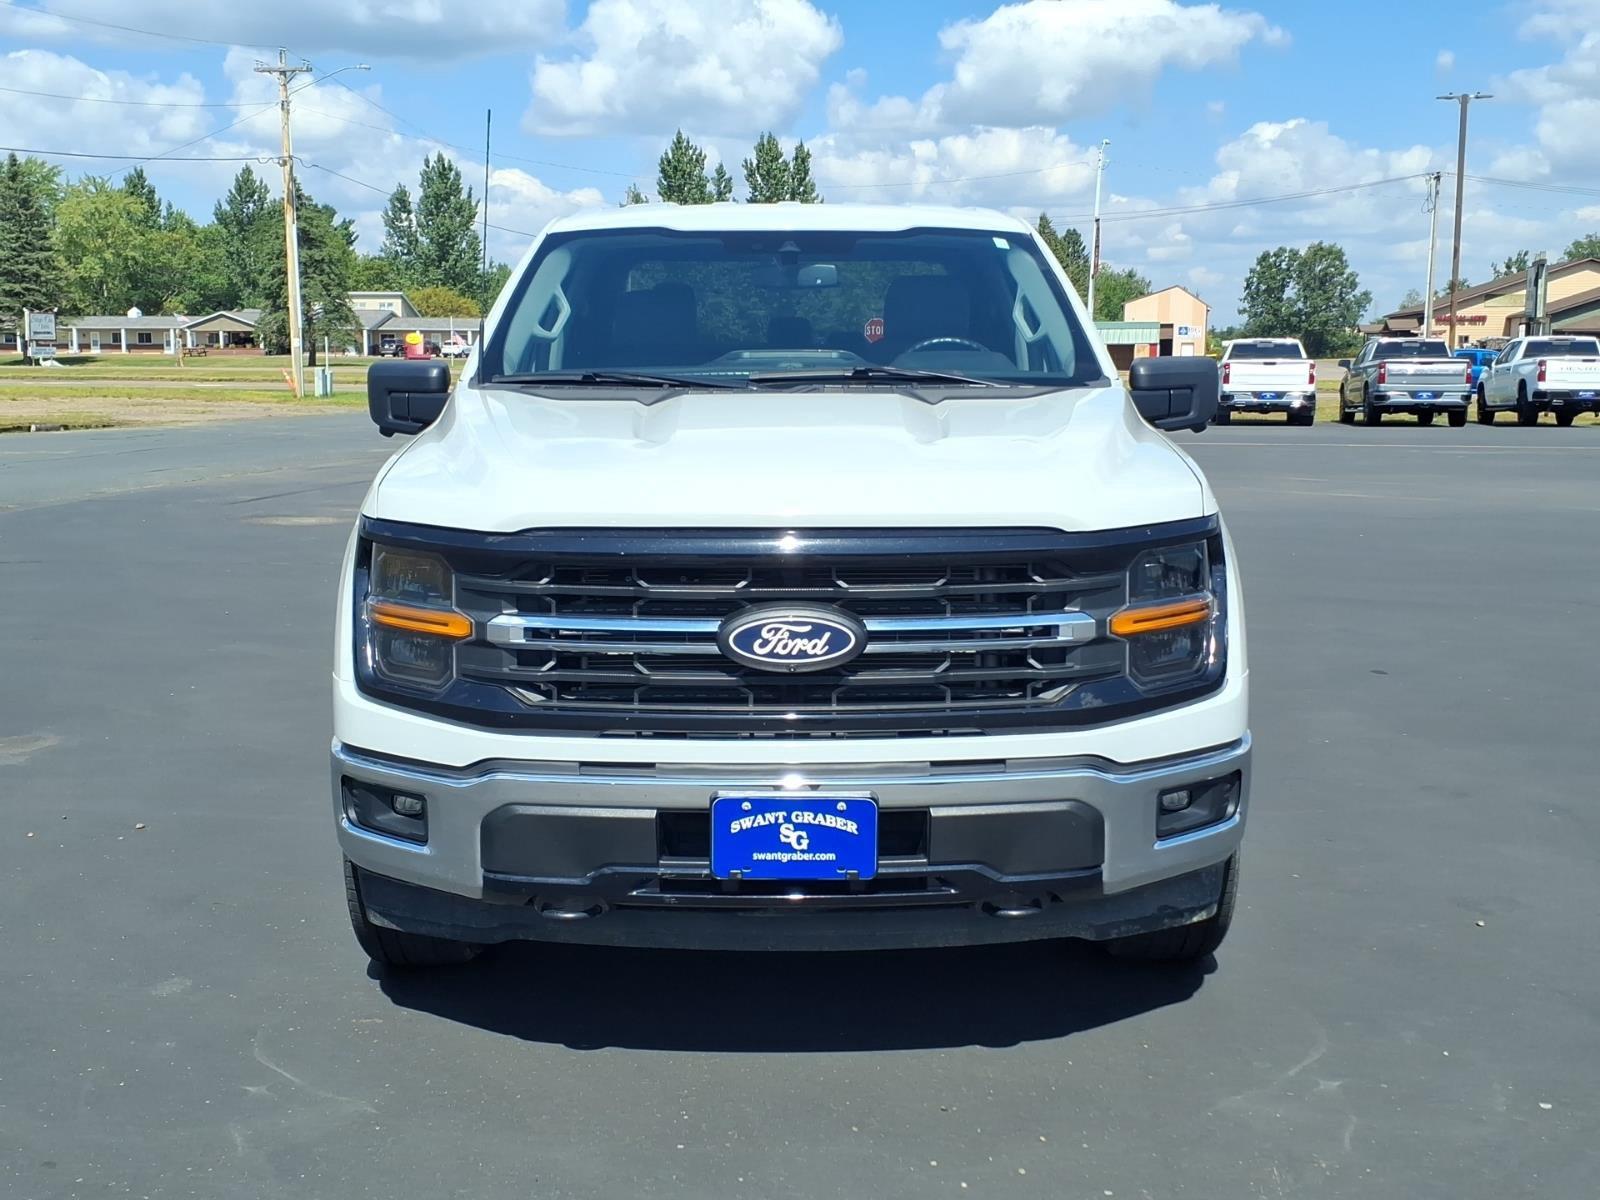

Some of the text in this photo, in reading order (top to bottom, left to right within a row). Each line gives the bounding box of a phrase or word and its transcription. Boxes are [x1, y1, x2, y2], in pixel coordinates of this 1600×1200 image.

[866, 325, 883, 335] STO
[752, 623, 832, 656] Ford
[730, 810, 859, 835] SWANT GRABER
[779, 823, 810, 850] SG
[752, 851, 836, 863] swantgraber.com
